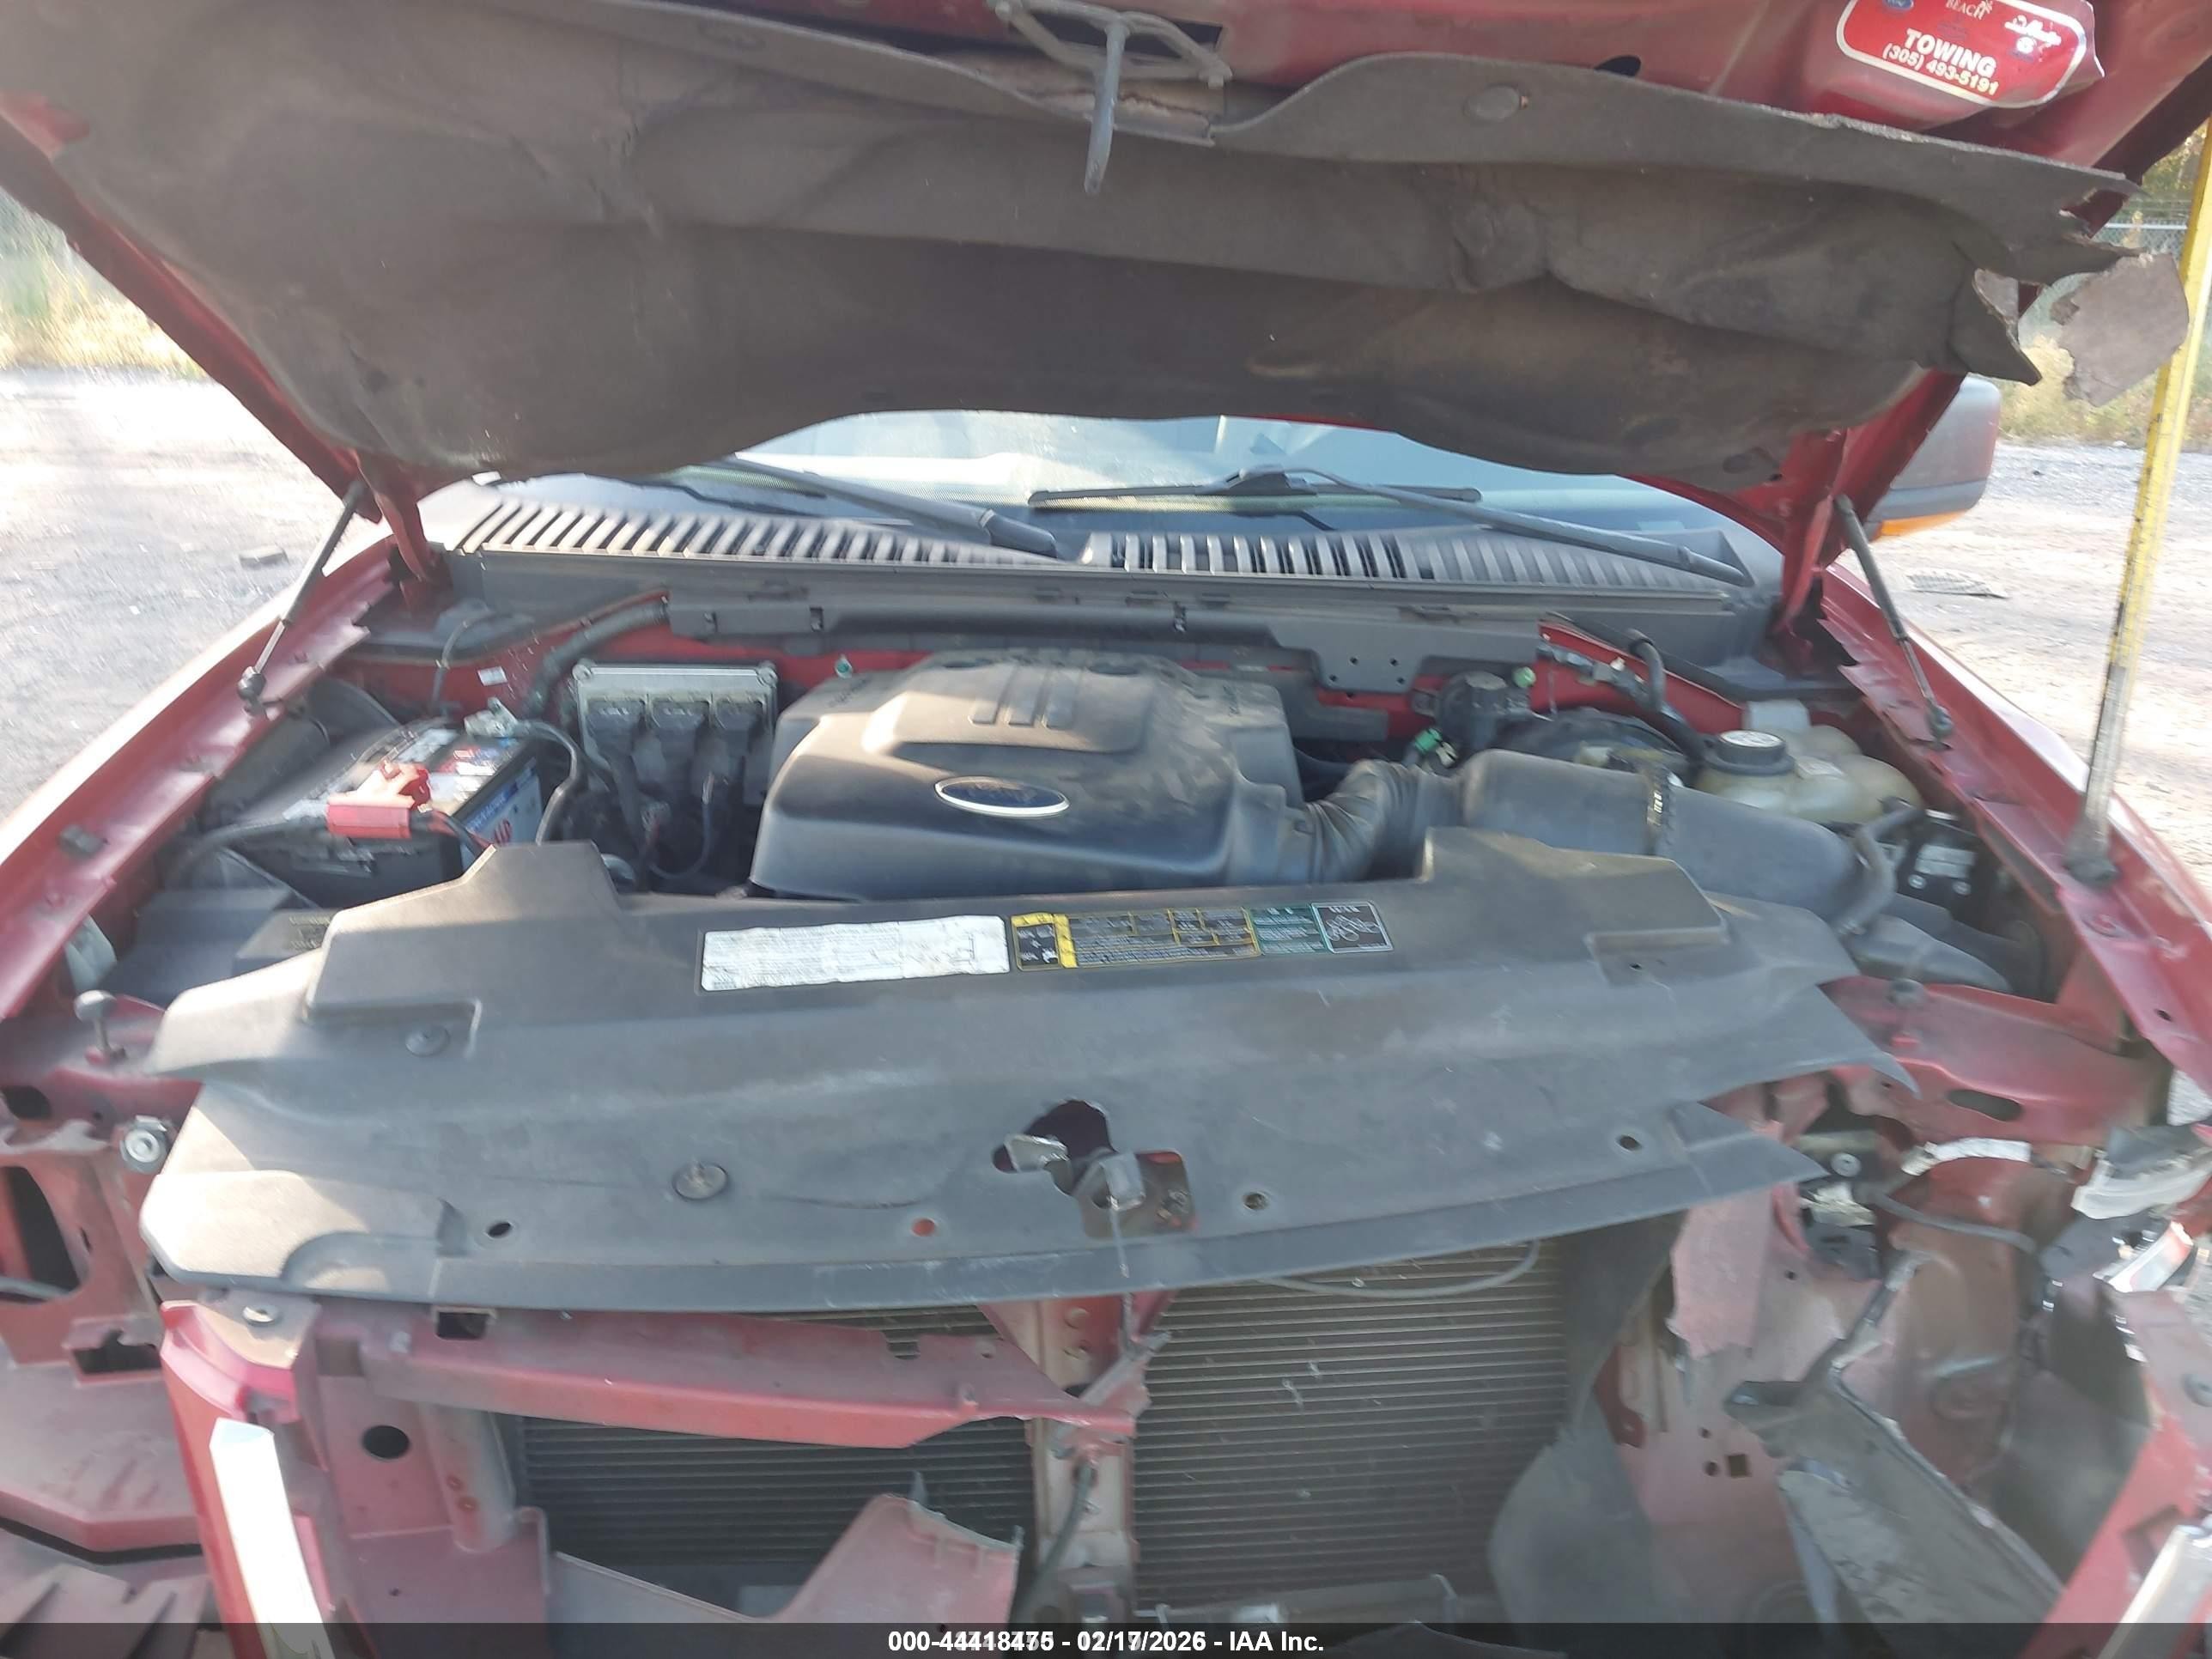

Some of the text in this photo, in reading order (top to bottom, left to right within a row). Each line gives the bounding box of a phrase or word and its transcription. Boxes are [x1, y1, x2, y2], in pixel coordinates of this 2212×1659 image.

[1946, 0, 1985, 20] BEACH
[1883, 43, 1924, 70] (305)
[1905, 29, 1996, 78] TOWING
